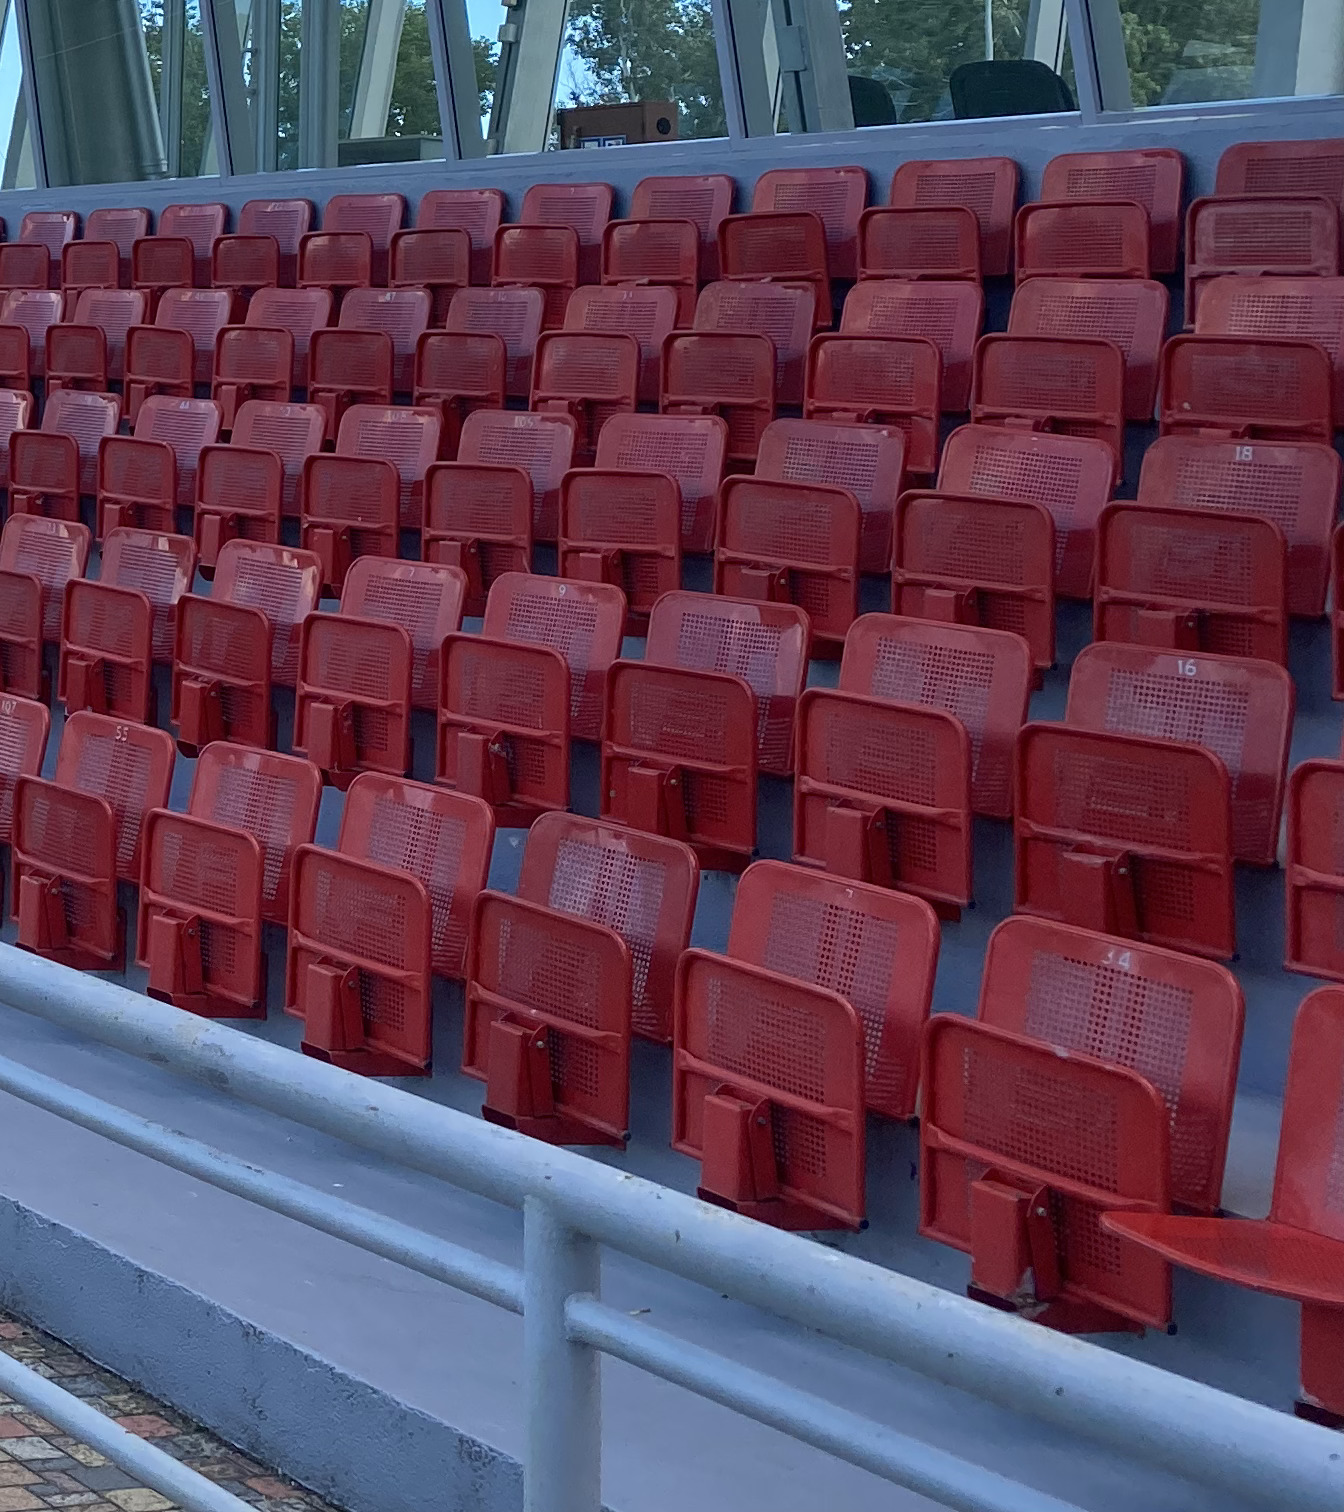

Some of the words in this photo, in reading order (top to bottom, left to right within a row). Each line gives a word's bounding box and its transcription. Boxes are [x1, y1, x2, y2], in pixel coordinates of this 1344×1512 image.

[1235, 445, 1253, 461] 18
[558, 584, 567, 598] 9
[1177, 659, 1198, 677] 16
[114, 725, 130, 742] 55
